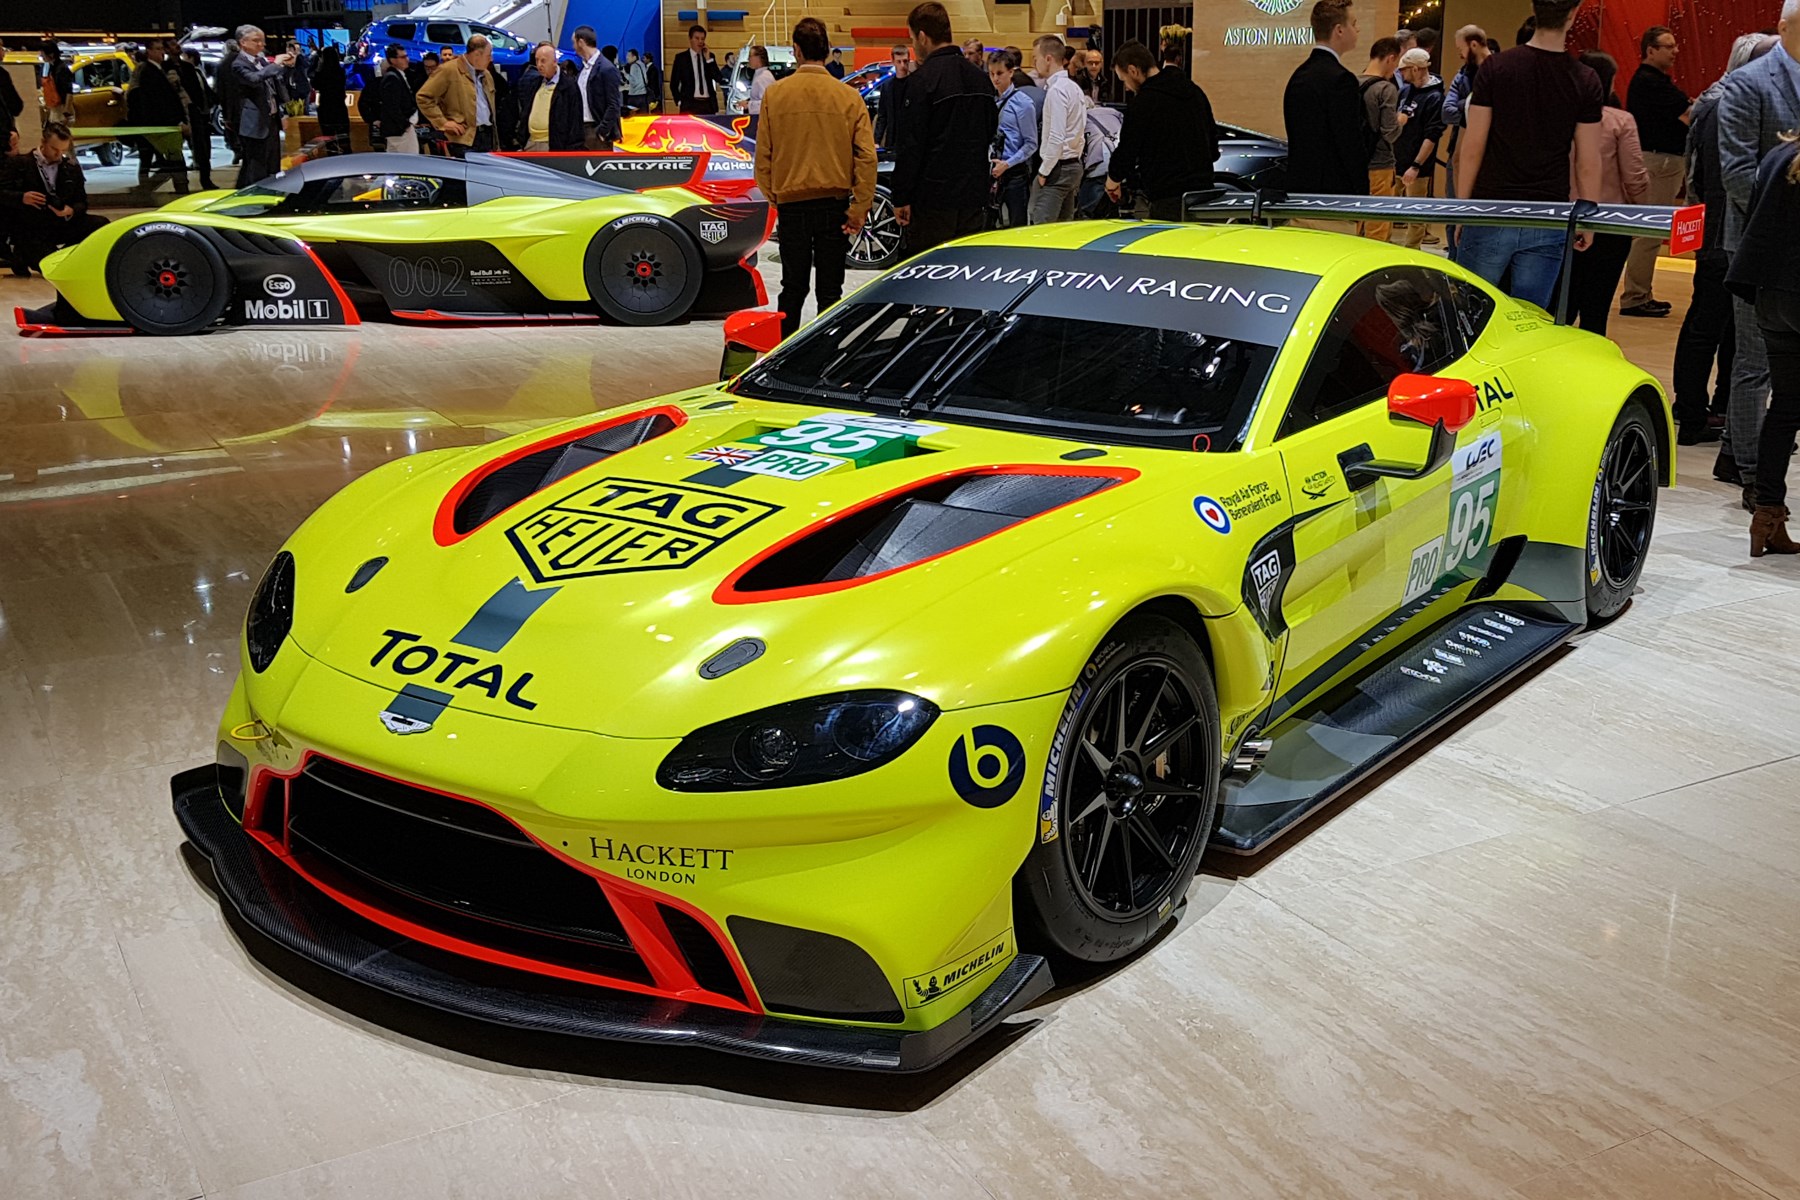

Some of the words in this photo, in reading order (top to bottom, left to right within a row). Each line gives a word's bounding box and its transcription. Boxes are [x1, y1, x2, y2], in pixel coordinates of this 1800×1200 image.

[1223, 27, 1268, 46] ASTON
[1274, 26, 1316, 46] MART
[585, 159, 693, 177] VALKYRIE
[708, 162, 730, 171] TAG
[621, 215, 659, 226] MICHELIN
[1340, 201, 1497, 213] MARTIN
[702, 223, 725, 231] TAG
[388, 256, 468, 297] 002
[882, 264, 986, 282] ASTON
[980, 266, 1124, 292] MARTIN
[1126, 277, 1292, 314] RACING
[245, 299, 306, 320] Mobil
[1474, 376, 1515, 412] TAL
[759, 422, 905, 454] 95
[1465, 438, 1495, 470] WEC
[745, 453, 831, 476] PRO
[588, 484, 750, 530] TAG
[1219, 490, 1242, 508] Royal
[1238, 487, 1251, 500] Air
[1248, 481, 1270, 497] Force
[1228, 496, 1267, 520] Benevolent
[1262, 489, 1282, 507] Fund
[1445, 480, 1496, 572] 95
[1589, 485, 1600, 557] MICHELIN
[525, 514, 700, 571] HEUER
[1253, 557, 1278, 587] TAG
[1405, 546, 1439, 597] PRO
[369, 629, 538, 712] TOTAL
[1044, 680, 1085, 798] MICHELIN
[588, 836, 735, 871] HACKETT
[626, 867, 696, 885] LONDON
[943, 941, 1005, 987] MICHELIN
